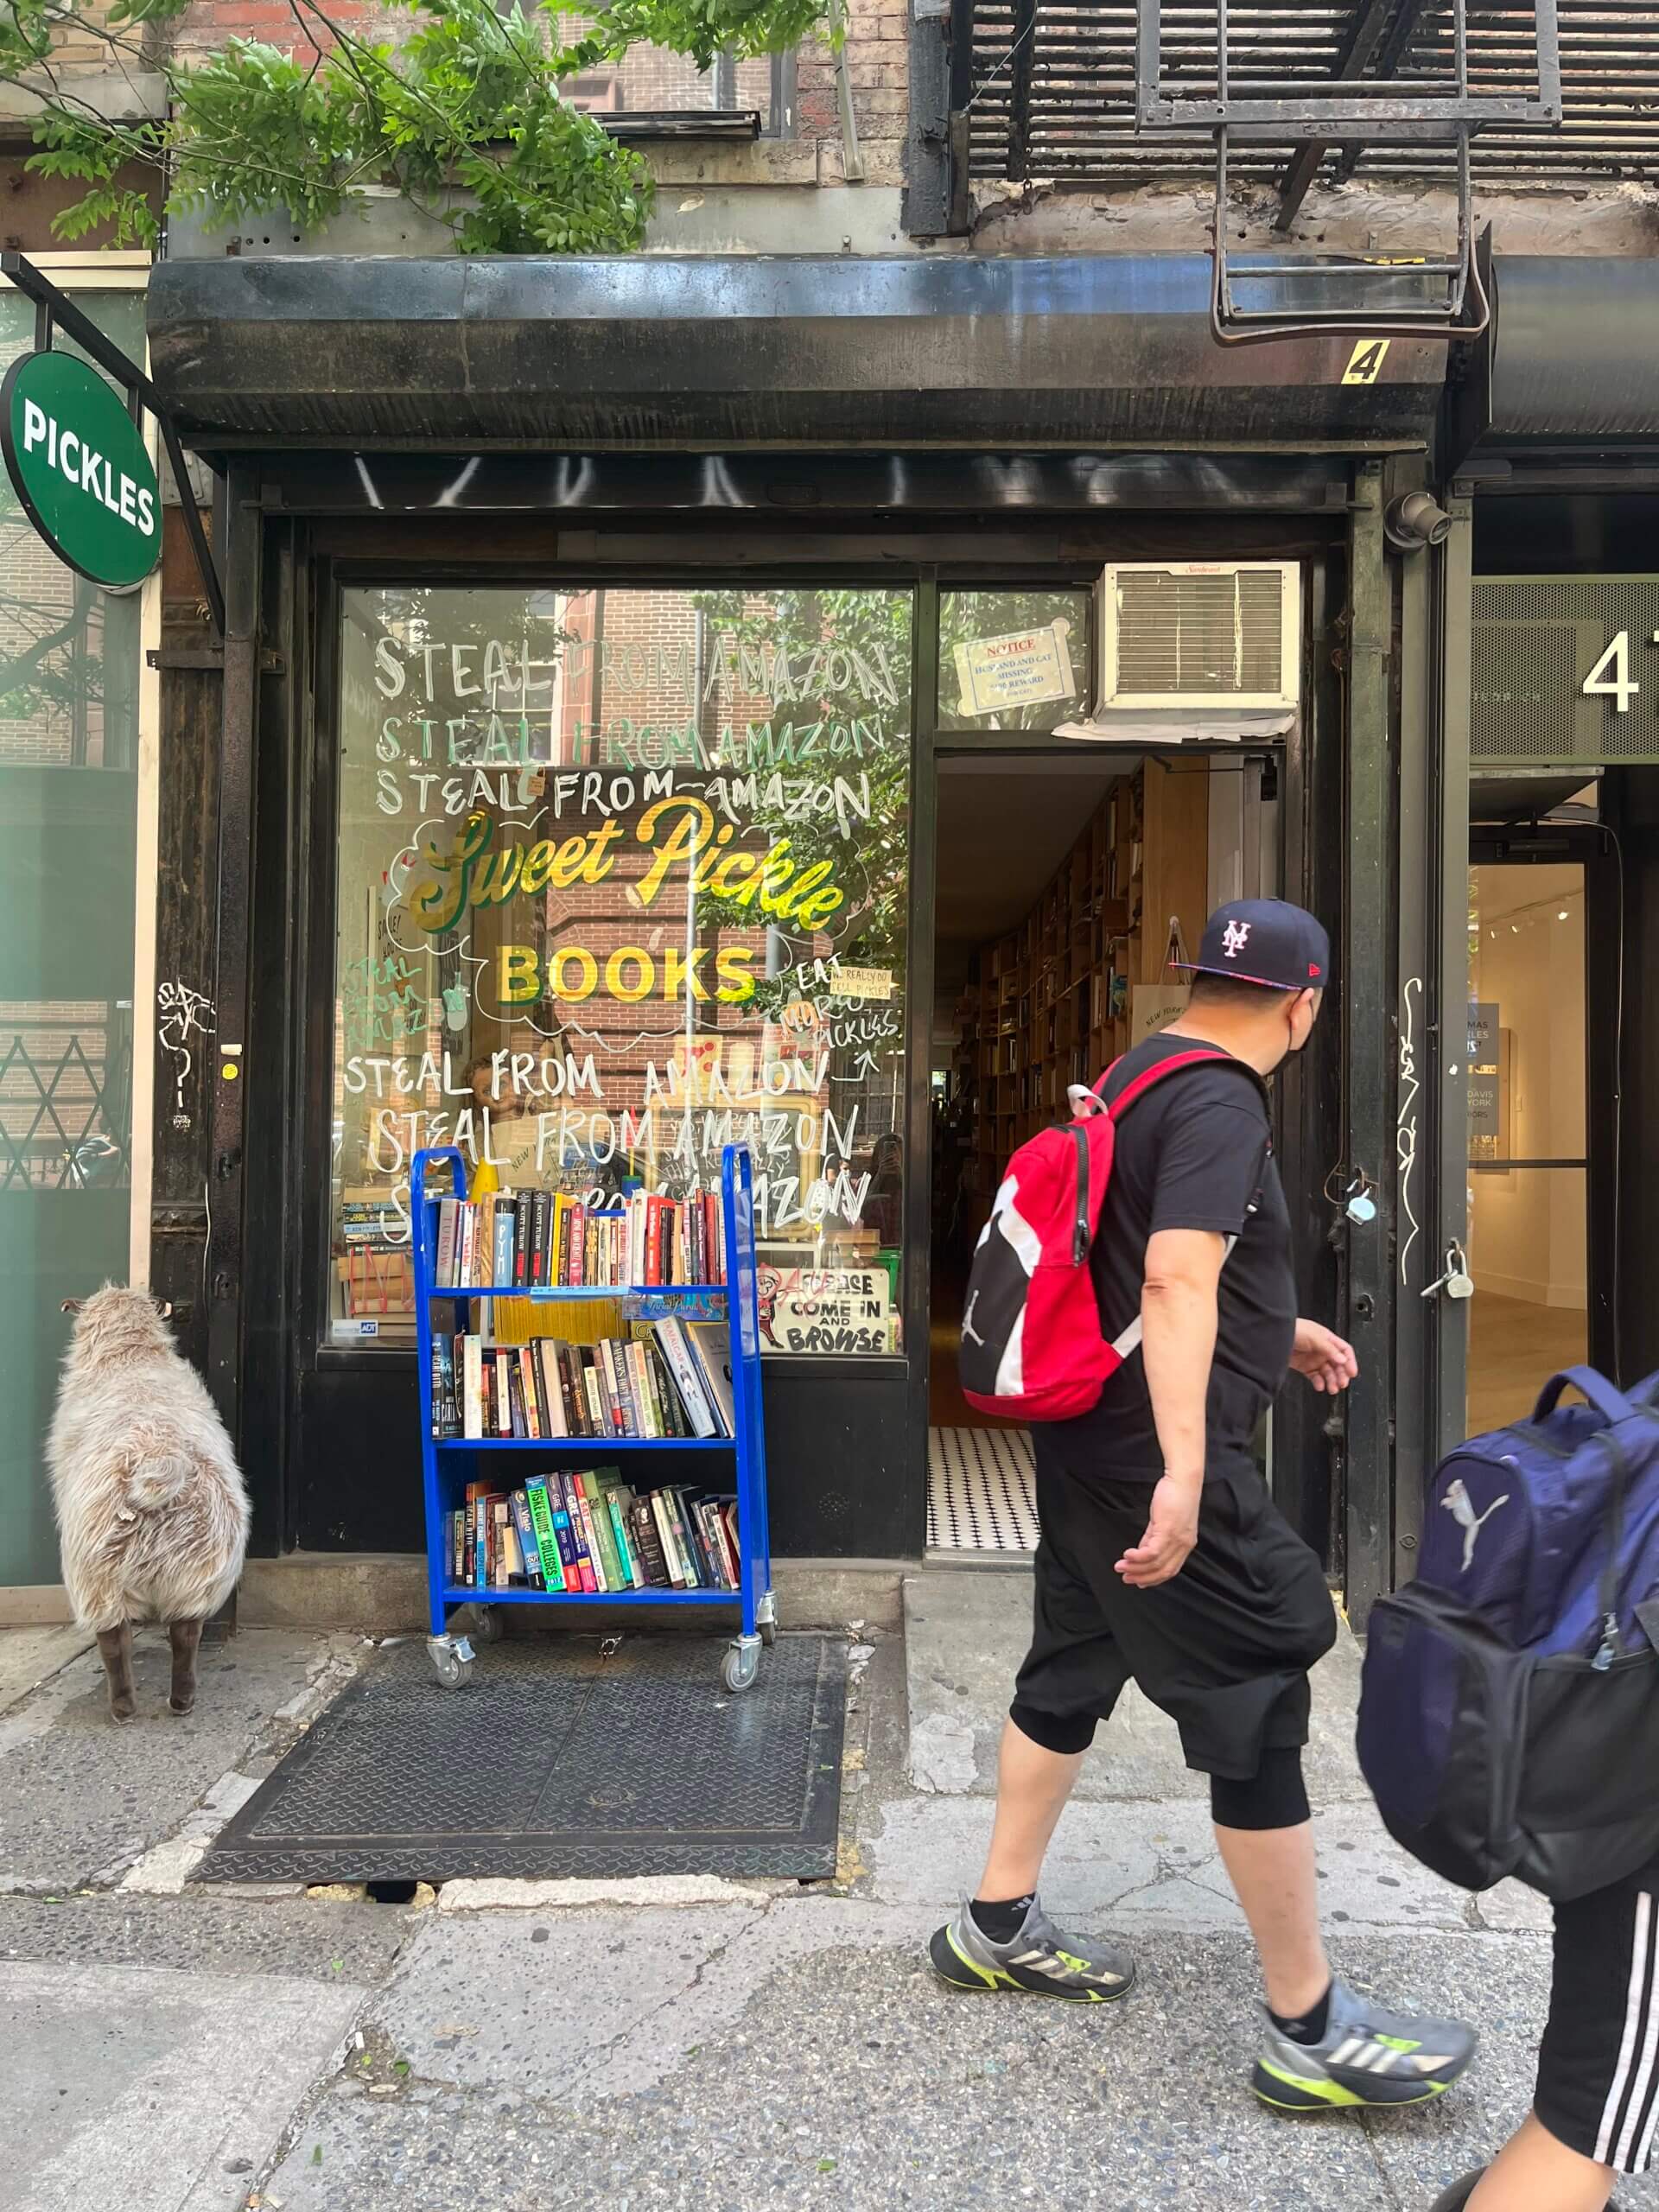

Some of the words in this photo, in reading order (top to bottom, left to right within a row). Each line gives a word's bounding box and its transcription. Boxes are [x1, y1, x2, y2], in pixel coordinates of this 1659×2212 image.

[1349, 342, 1383, 380] 4
[23, 397, 155, 537] PICKLES
[987, 639, 1036, 658] NOTICE
[374, 637, 551, 702] STEAL
[562, 639, 692, 705] FROM
[704, 636, 899, 707] AMAZON
[1583, 630, 1659, 712] 4
[376, 715, 545, 767] STEAL
[573, 717, 712, 772] FROM
[716, 713, 886, 770] AMAZON
[376, 768, 528, 816] STEAL
[554, 769, 674, 819] FROM
[704, 772, 871, 826] AMAZON
[409, 807, 626, 934] Sweet
[635, 797, 846, 931] Pickle
[499, 945, 757, 1007] BOOKS
[796, 951, 842, 990] EAT
[847, 969, 875, 982] REALLY
[877, 971, 887, 982] DO
[856, 984, 889, 995] PICKLES
[344, 1050, 474, 1098] STEAL
[491, 1048, 605, 1101] FROM
[645, 1050, 830, 1109] AMAZON
[1466, 1090, 1494, 1098] DAVIS
[370, 1106, 512, 1173] STEAL
[536, 1105, 656, 1172] FROM
[673, 1104, 860, 1171] AMAZON
[440, 1217, 453, 1268] TUROW
[361, 1323, 376, 1332] ADT
[791, 1300, 851, 1318] COME
[861, 1300, 881, 1318] IN
[819, 1317, 851, 1325] AND
[786, 1325, 886, 1353] BROWSE
[530, 1488, 546, 1512] FISKE
[552, 1492, 561, 1510] GRE
[559, 1530, 568, 1544] 2019
[566, 1495, 580, 1519] GRE
[520, 1507, 532, 1532] Visio
[536, 1510, 550, 1535] GUIDE
[540, 1538, 558, 1577] COLLEGES
